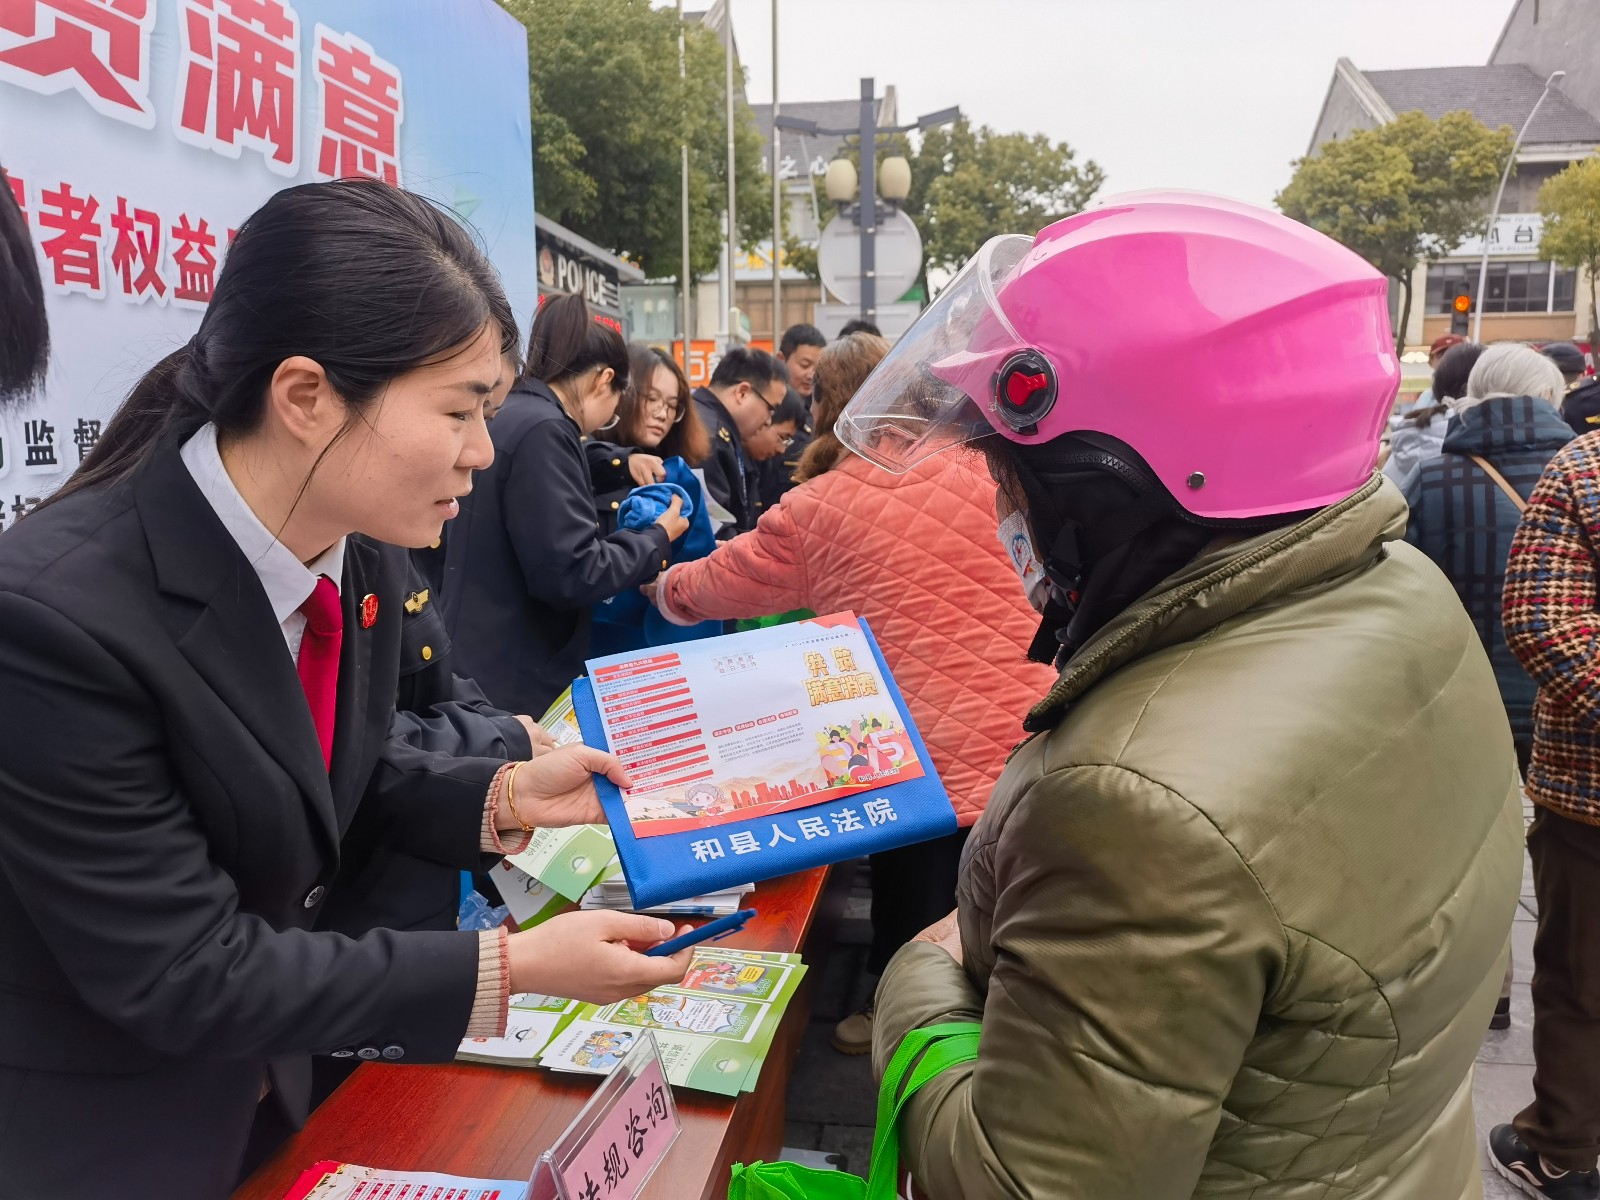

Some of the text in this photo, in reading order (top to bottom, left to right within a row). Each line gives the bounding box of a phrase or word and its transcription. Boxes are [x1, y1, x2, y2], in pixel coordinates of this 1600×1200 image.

[0, 167, 239, 303] 者权益
[557, 253, 607, 306] POLICE
[805, 672, 879, 707] 满意消费
[690, 797, 898, 863] 和县人民法院
